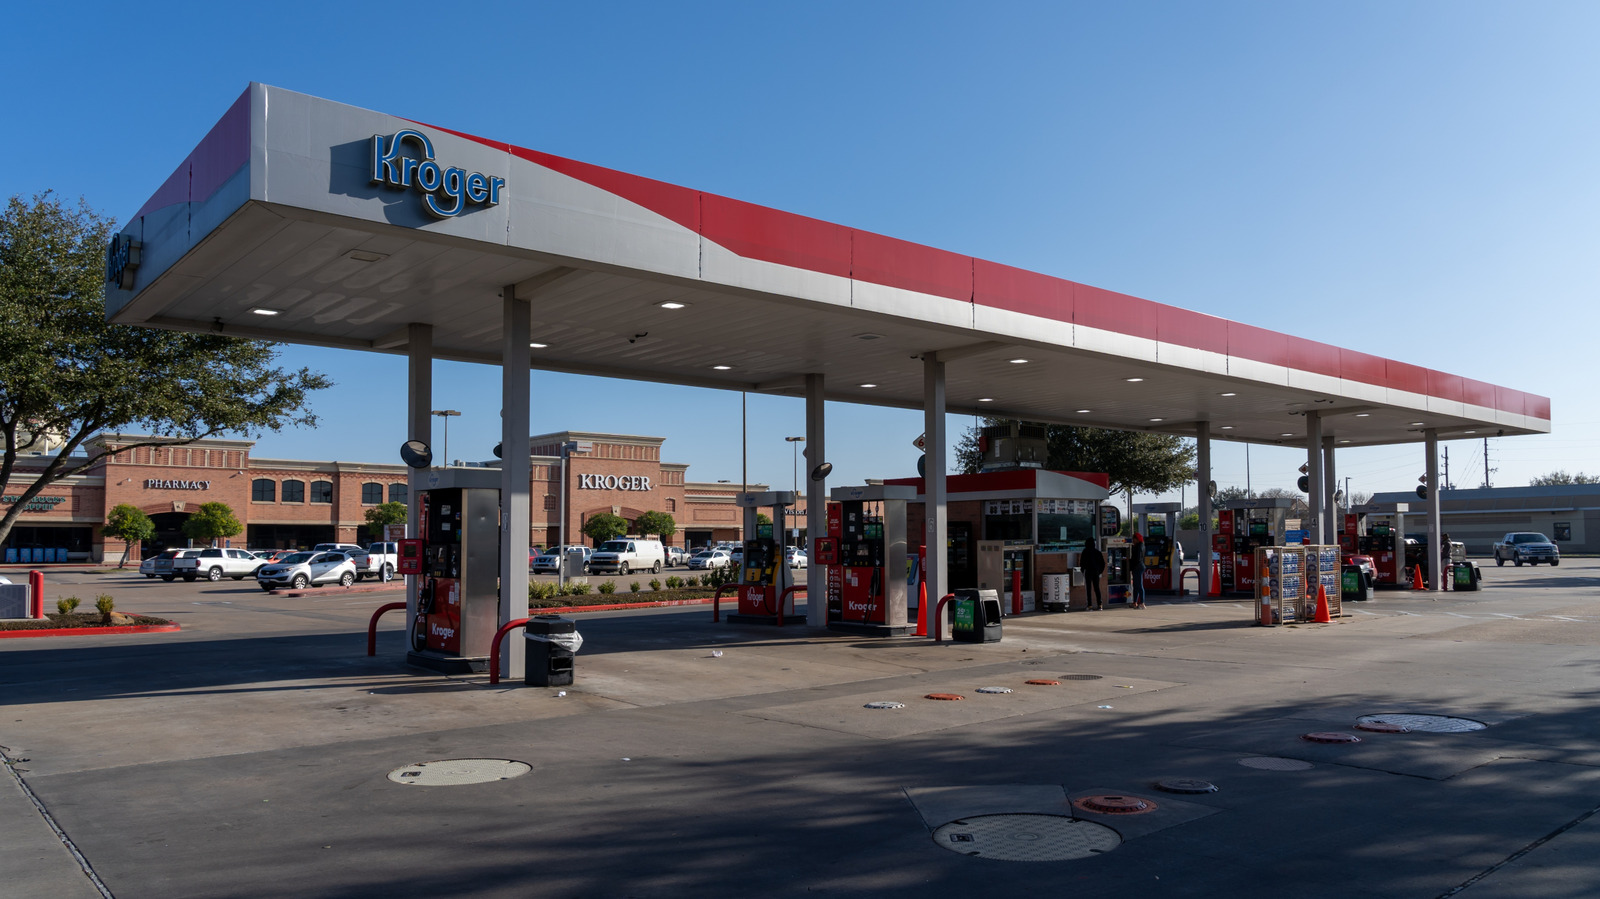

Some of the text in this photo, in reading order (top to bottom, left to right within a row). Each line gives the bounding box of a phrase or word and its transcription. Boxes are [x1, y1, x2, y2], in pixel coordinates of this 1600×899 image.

[371, 128, 505, 219] Kroger
[147, 478, 211, 490] PHARMACY
[580, 473, 652, 490] KROGER
[2, 495, 66, 503] STABUCKS
[22, 503, 55, 511] OFFEE
[928, 518, 934, 531] 6
[1199, 522, 1207, 532] 10
[746, 586, 764, 608] Kroger
[848, 600, 878, 613] Kroger
[431, 622, 455, 640] Kroger
